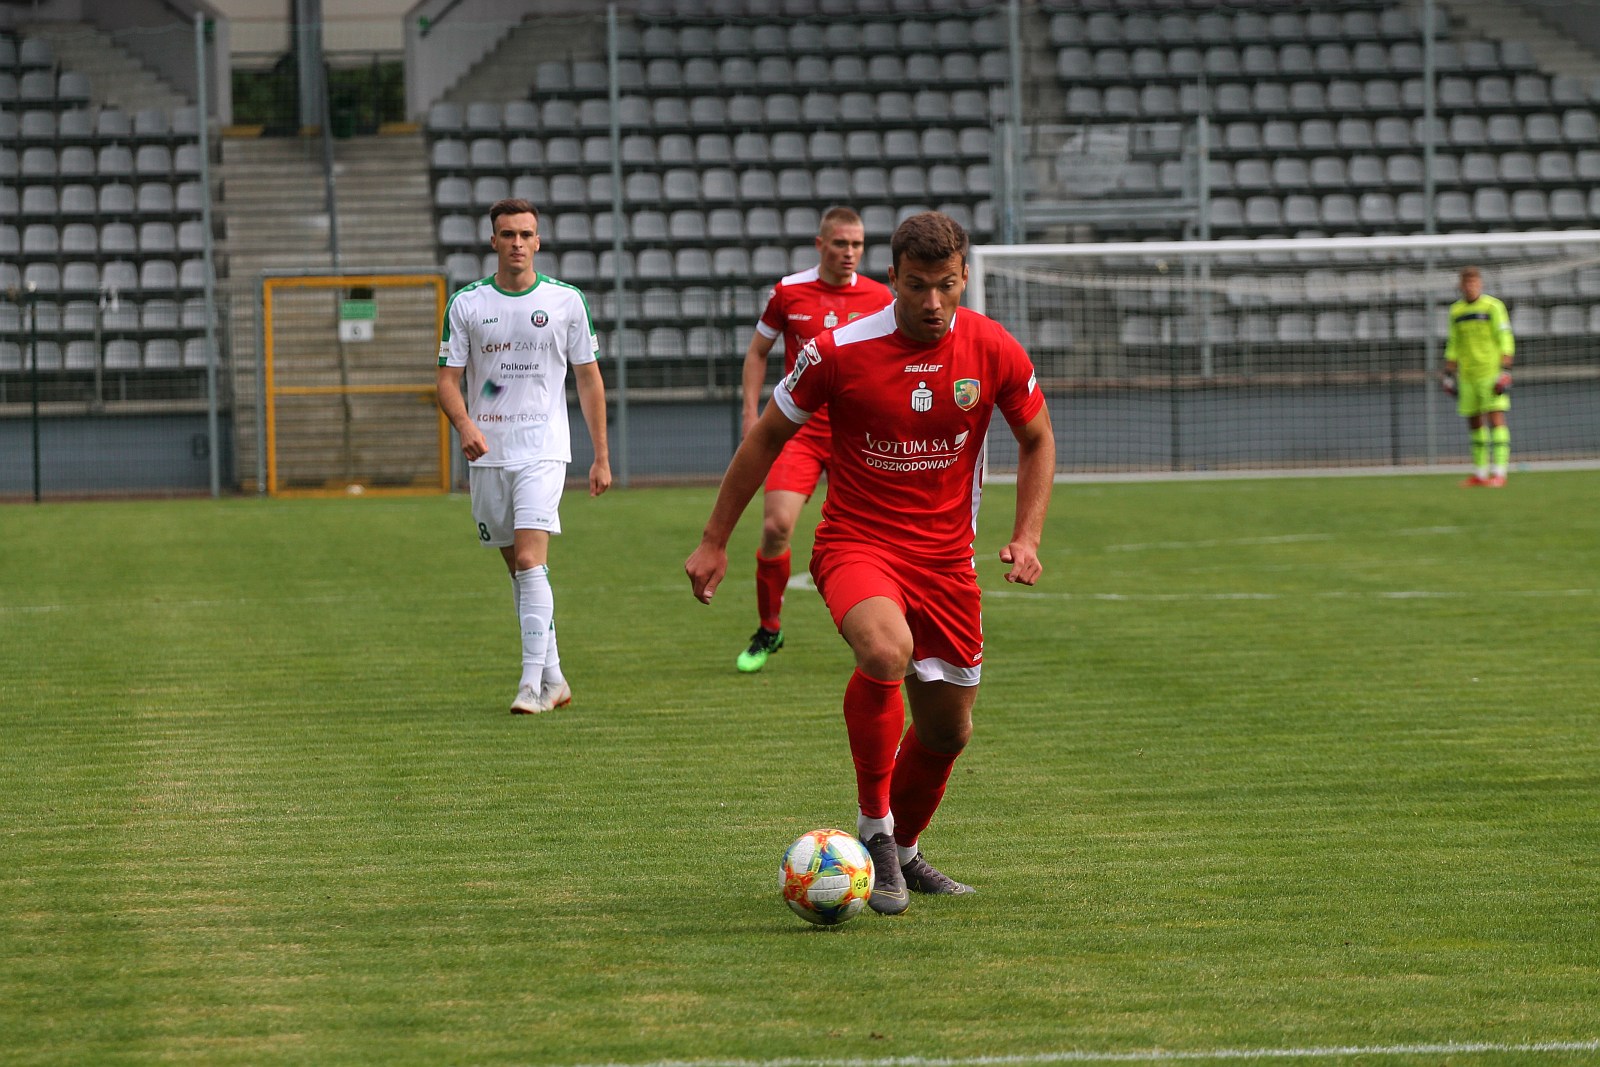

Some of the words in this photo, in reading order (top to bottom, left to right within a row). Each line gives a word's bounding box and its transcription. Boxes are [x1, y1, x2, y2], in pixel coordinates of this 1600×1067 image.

[482, 317, 499, 325] JAKO
[514, 341, 553, 352] ZANAM
[500, 362, 540, 371] Polkowice
[904, 363, 943, 373] saller
[476, 414, 503, 422] KGHM
[865, 431, 928, 455] VOTUM
[931, 438, 950, 452] SA
